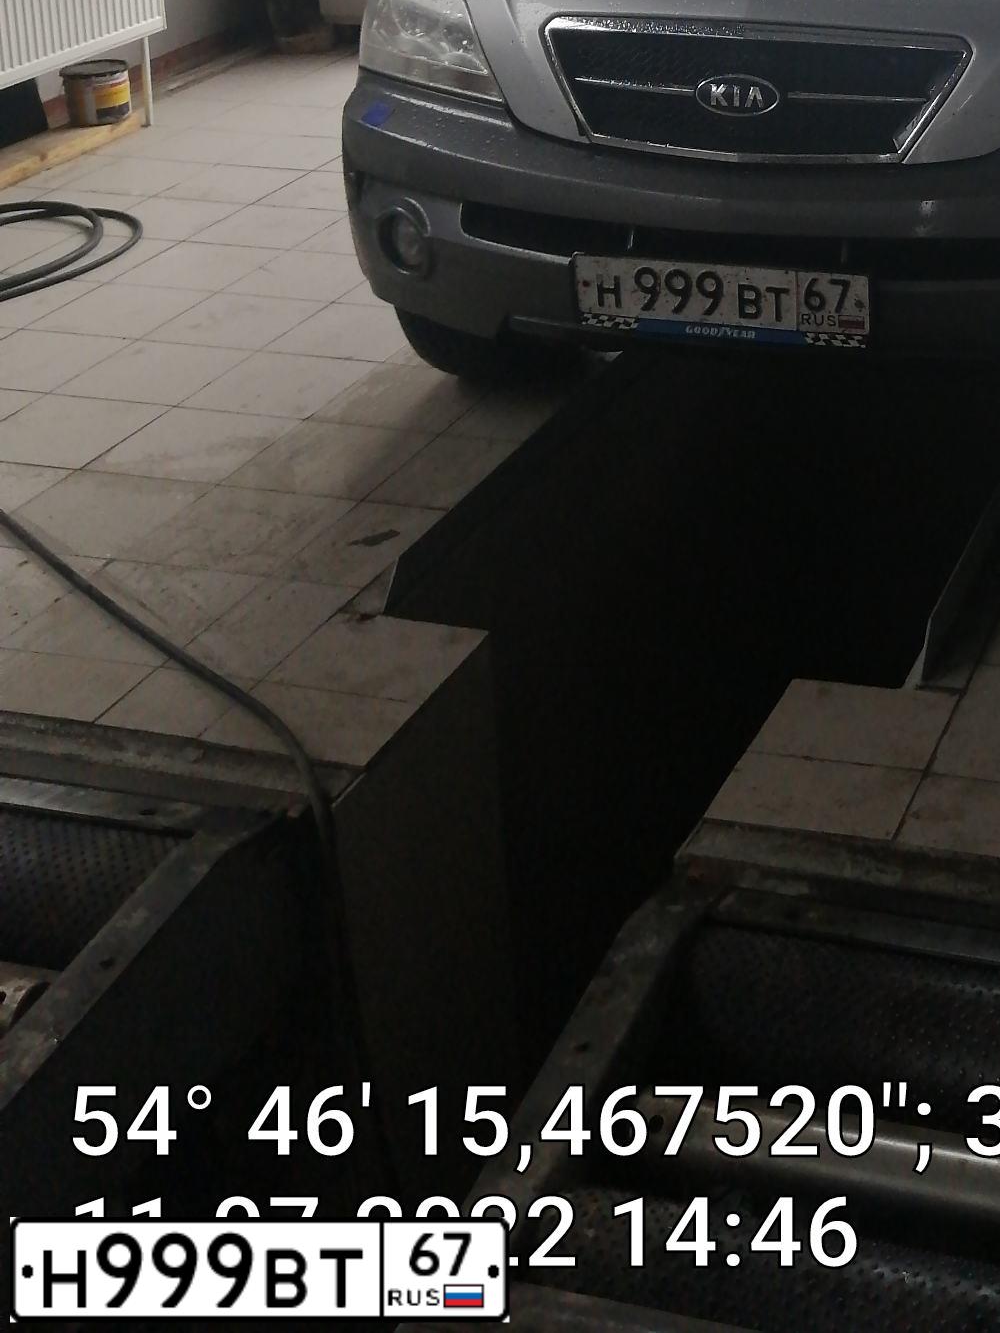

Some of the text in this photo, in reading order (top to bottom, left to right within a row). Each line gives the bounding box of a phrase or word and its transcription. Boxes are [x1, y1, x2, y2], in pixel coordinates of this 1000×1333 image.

[709, 83, 765, 108] KIA
[803, 277, 851, 314] 67
[800, 312, 837, 328] RUS
